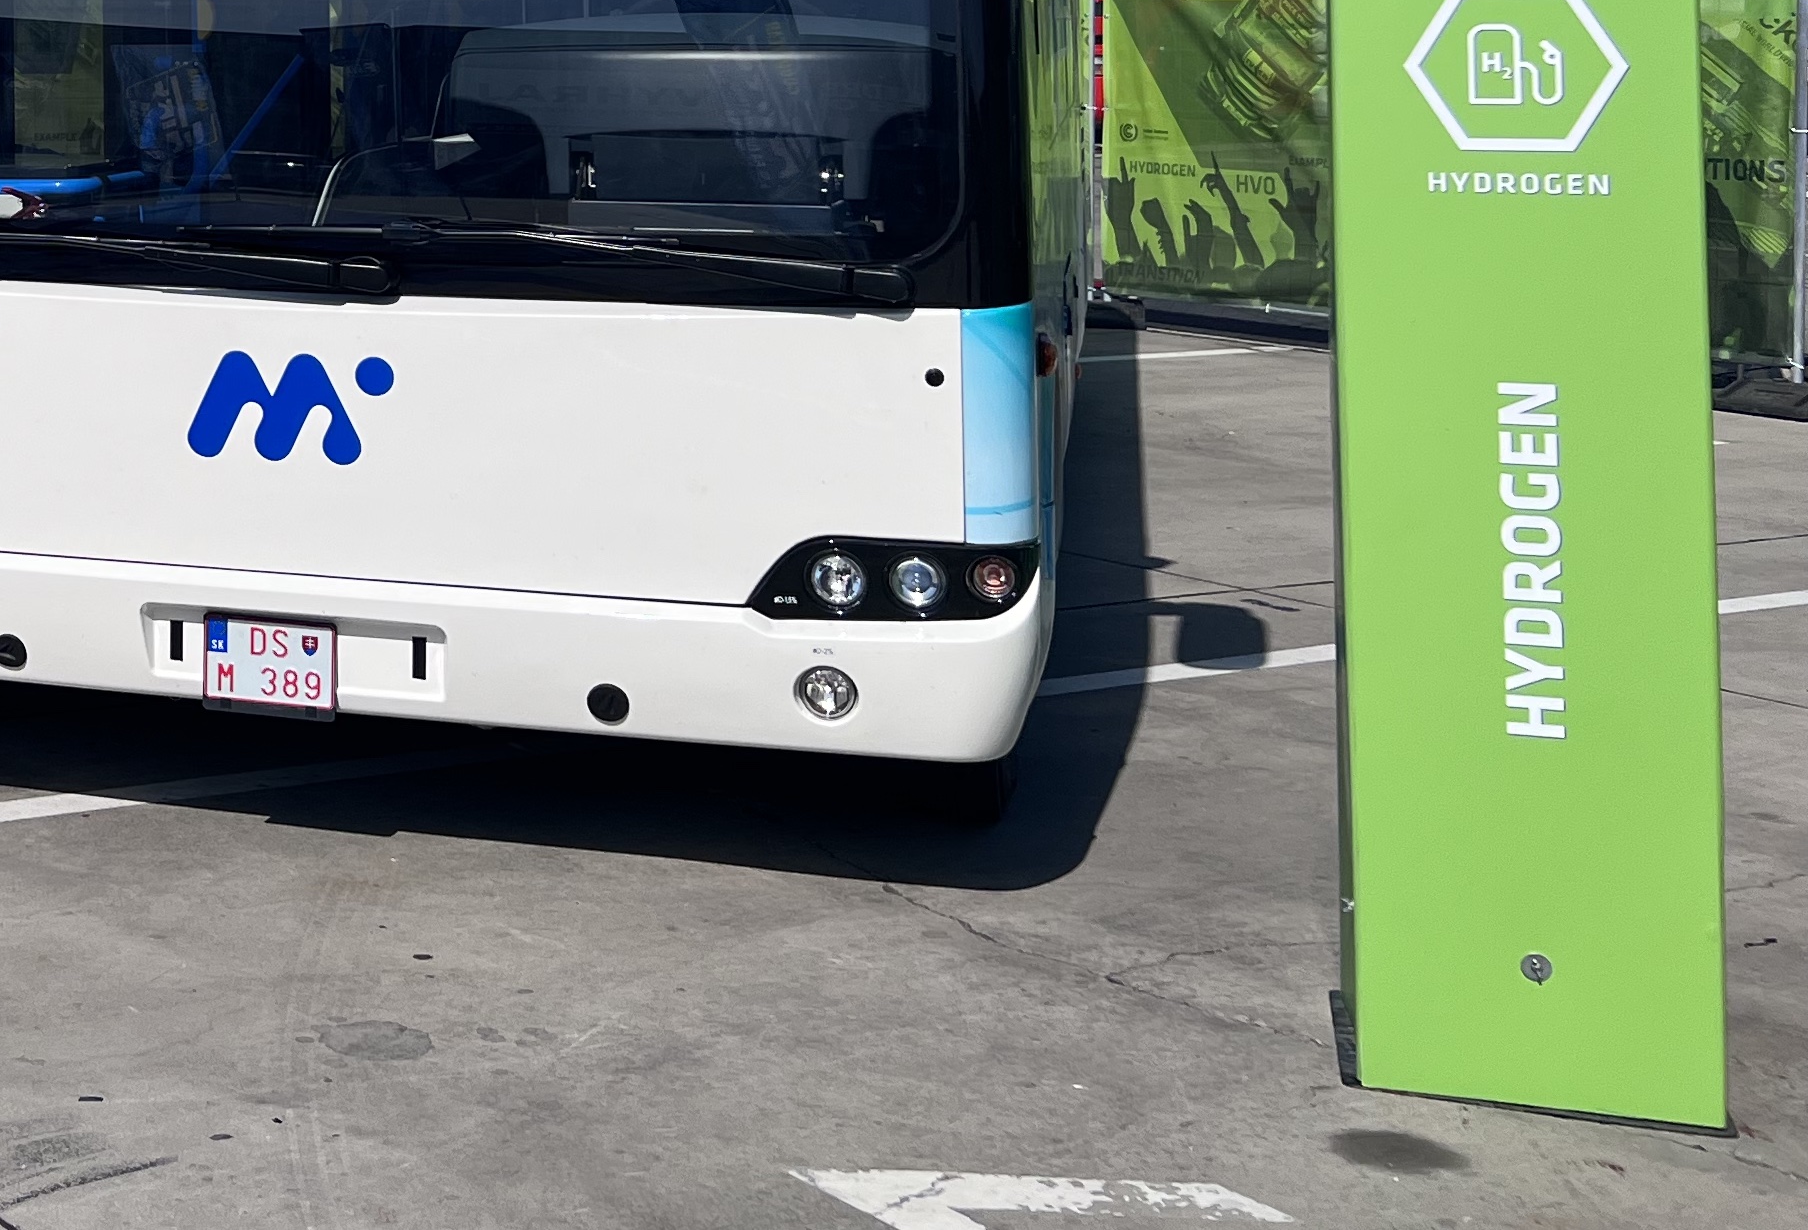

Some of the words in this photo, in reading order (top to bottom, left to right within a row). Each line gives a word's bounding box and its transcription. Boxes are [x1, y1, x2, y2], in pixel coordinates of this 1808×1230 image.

[1129, 160, 1196, 178] HYDROGEN
[1235, 174, 1276, 196] HVO
[1427, 171, 1611, 195] HYDROGEN
[1496, 381, 1566, 739] HYDROGEN
[211, 639, 224, 650] SK
[250, 626, 289, 658] DS
[217, 662, 234, 692] M
[260, 667, 321, 700] 389
